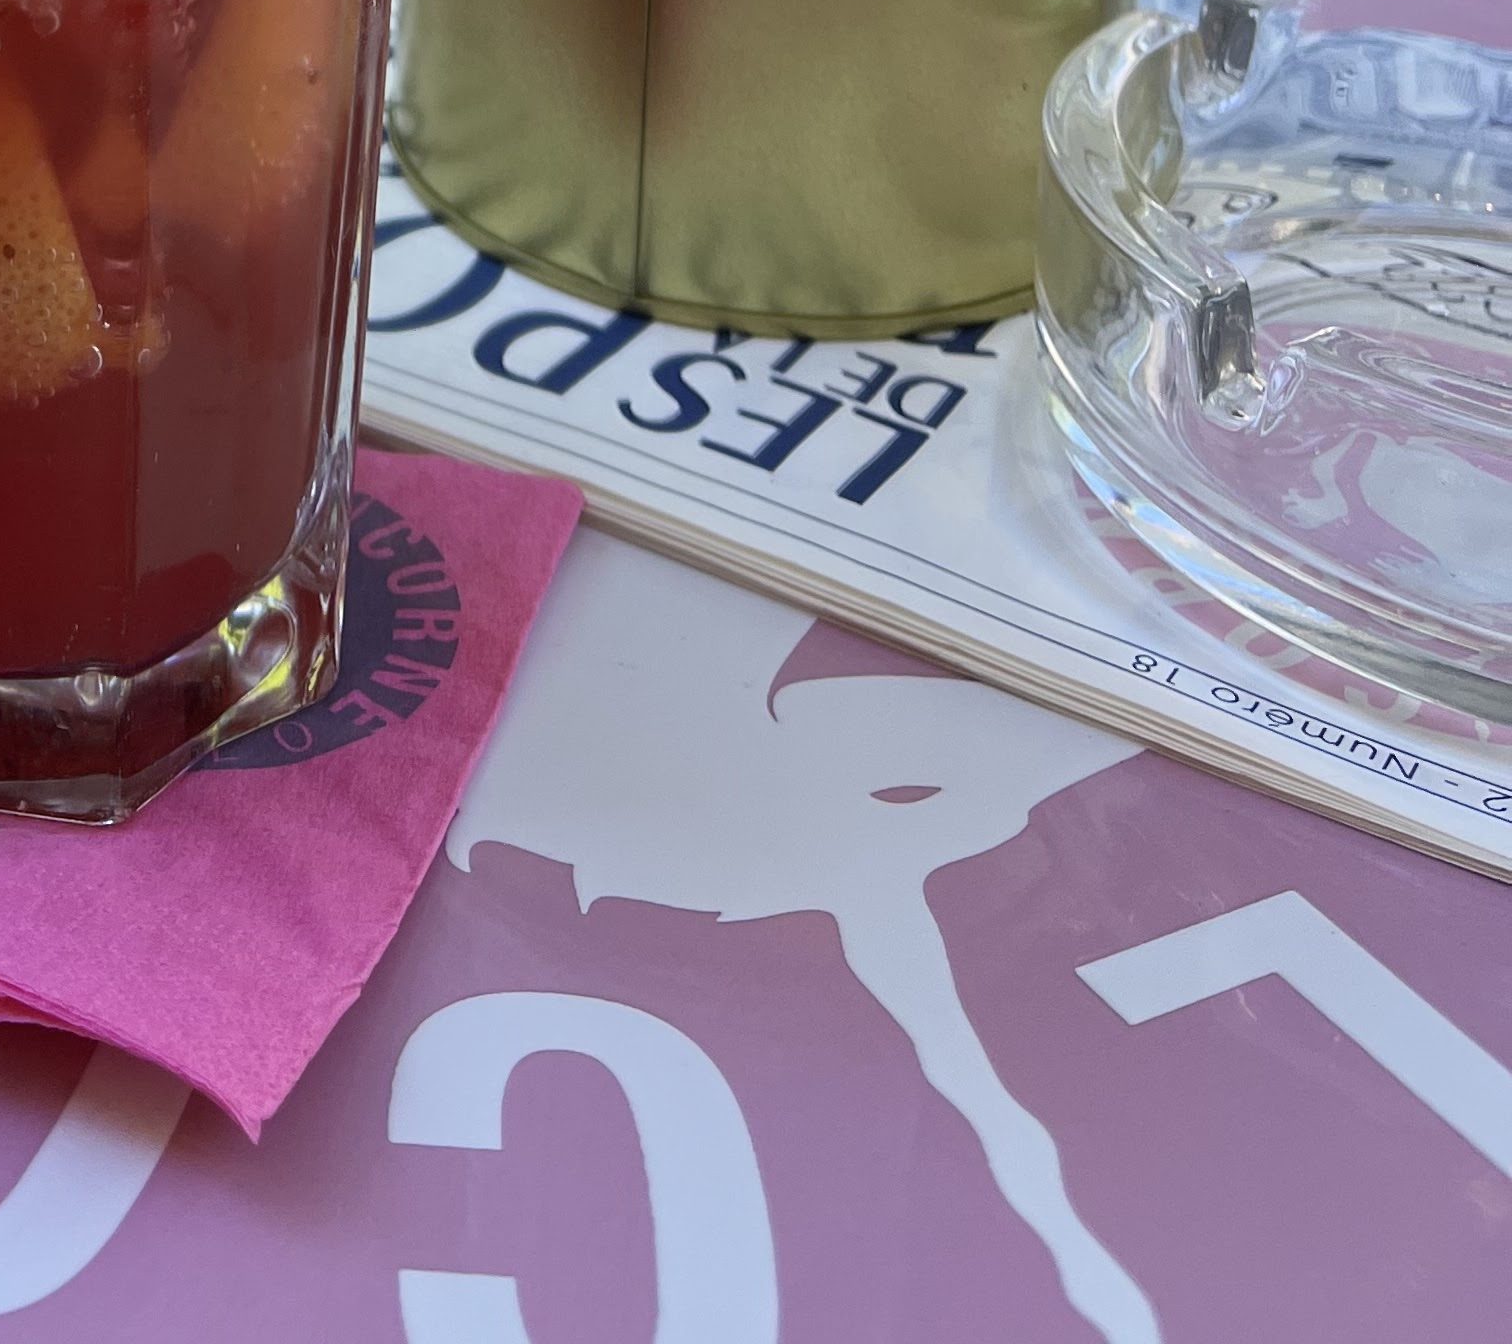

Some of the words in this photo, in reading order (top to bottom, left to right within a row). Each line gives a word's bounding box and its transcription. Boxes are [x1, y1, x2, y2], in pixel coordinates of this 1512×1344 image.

[618, 352, 929, 505] LES
[824, 350, 967, 429] DE
[329, 502, 459, 728] CORNE
[1131, 653, 1180, 686] 18
[1210, 685, 1420, 782] Numéro
